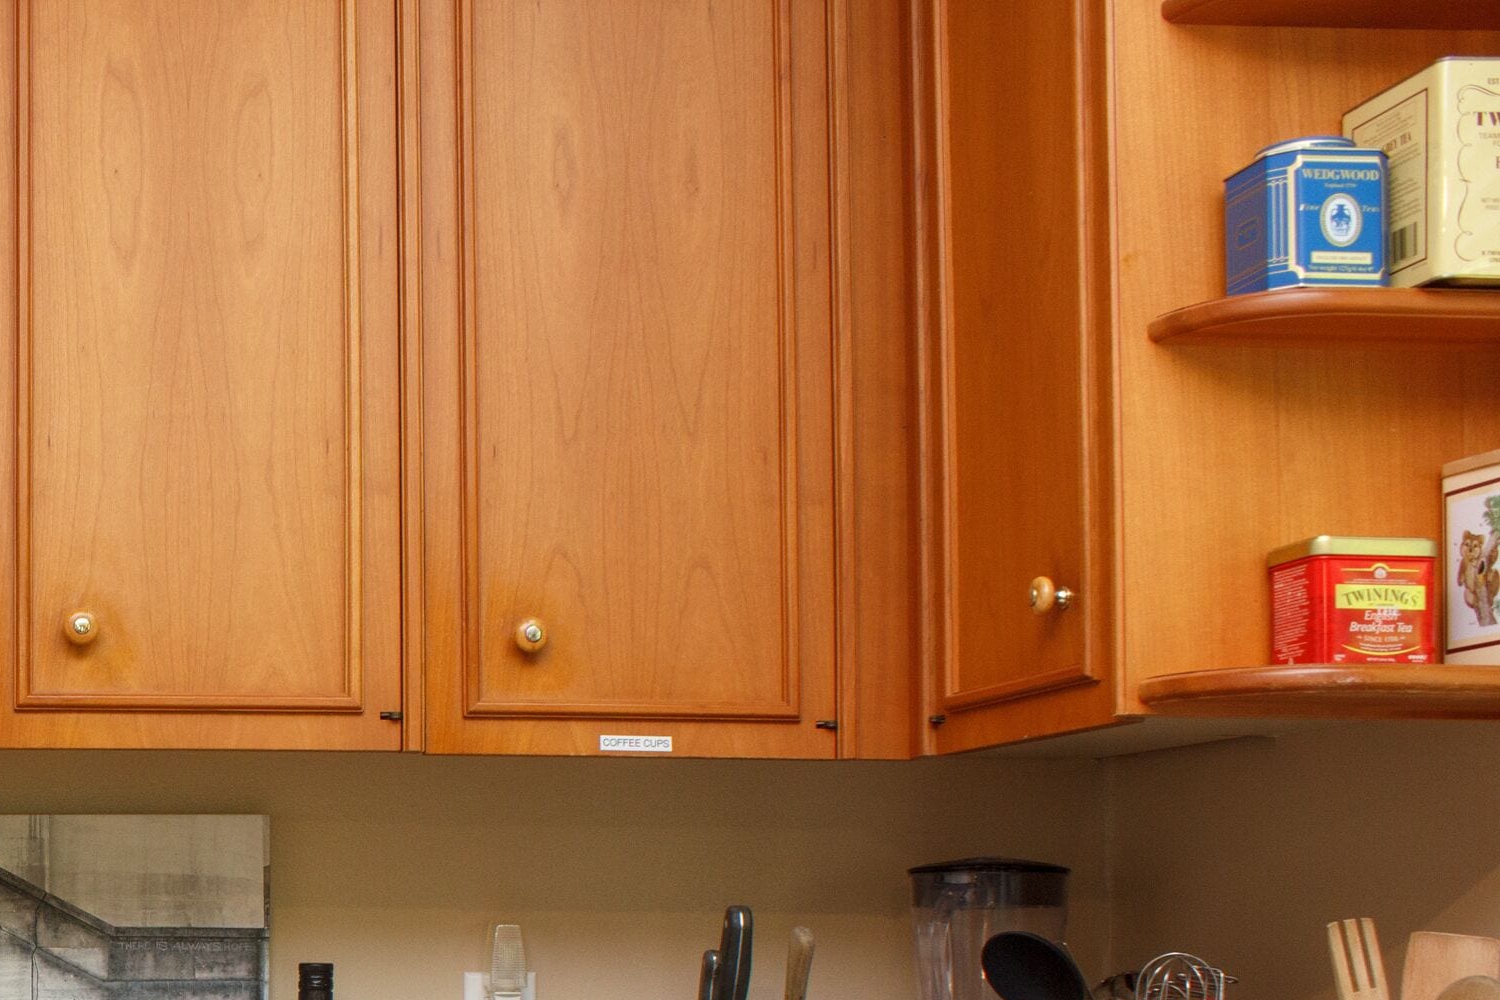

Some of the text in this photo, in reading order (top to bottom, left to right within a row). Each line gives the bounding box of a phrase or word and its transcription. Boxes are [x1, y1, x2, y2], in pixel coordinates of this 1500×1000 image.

[1302, 168, 1380, 180] WEDGWOOD
[1341, 587, 1419, 607] TWININGS
[1349, 621, 1413, 634] Breakfast Tea
[602, 738, 670, 748] COFFEE CUPS
[117, 940, 253, 952] THERE IS ALWAYS HOPE
